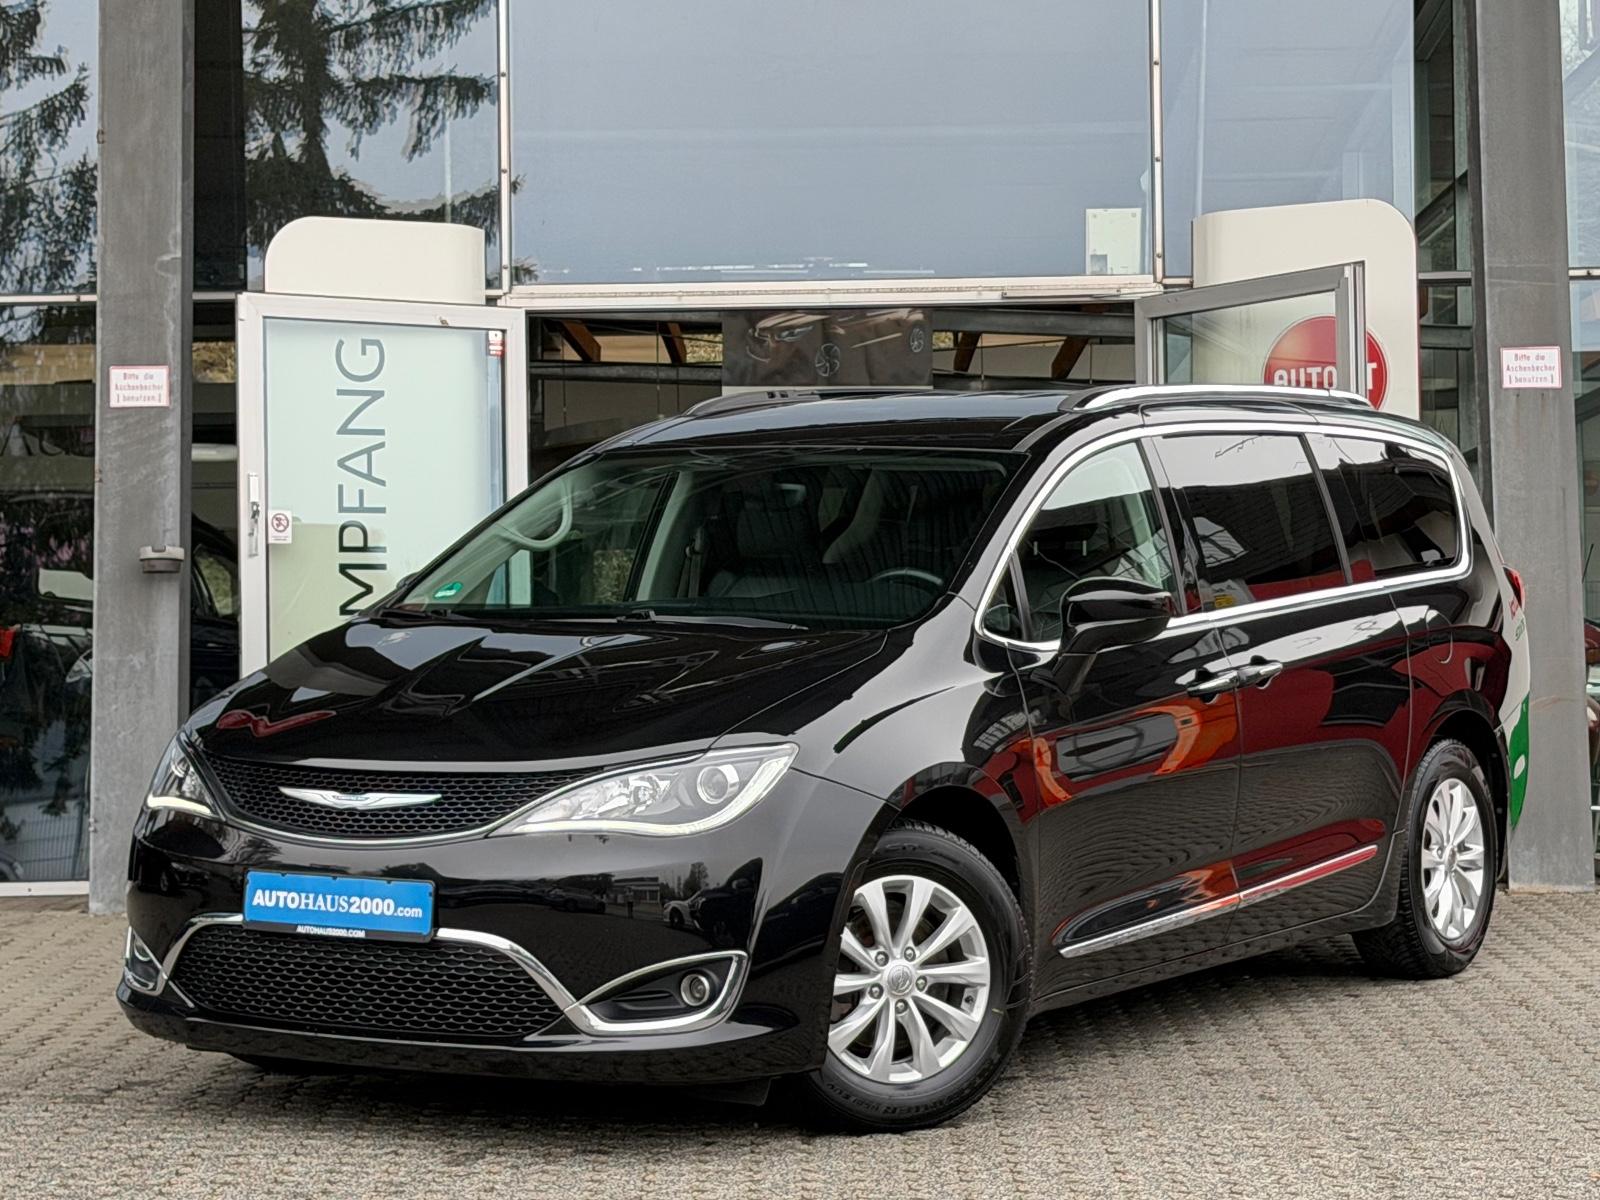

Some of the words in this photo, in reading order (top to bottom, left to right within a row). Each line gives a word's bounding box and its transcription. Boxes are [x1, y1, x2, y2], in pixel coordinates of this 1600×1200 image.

[1514, 352, 1531, 362] Bitte
[1534, 352, 1546, 361] die
[1506, 363, 1556, 373] Aschenbecher
[334, 337, 388, 616] MPFANG
[252, 888, 423, 918] AUTOHAUS2000.com
[296, 924, 366, 938] AUTOHAUS2000.COM
